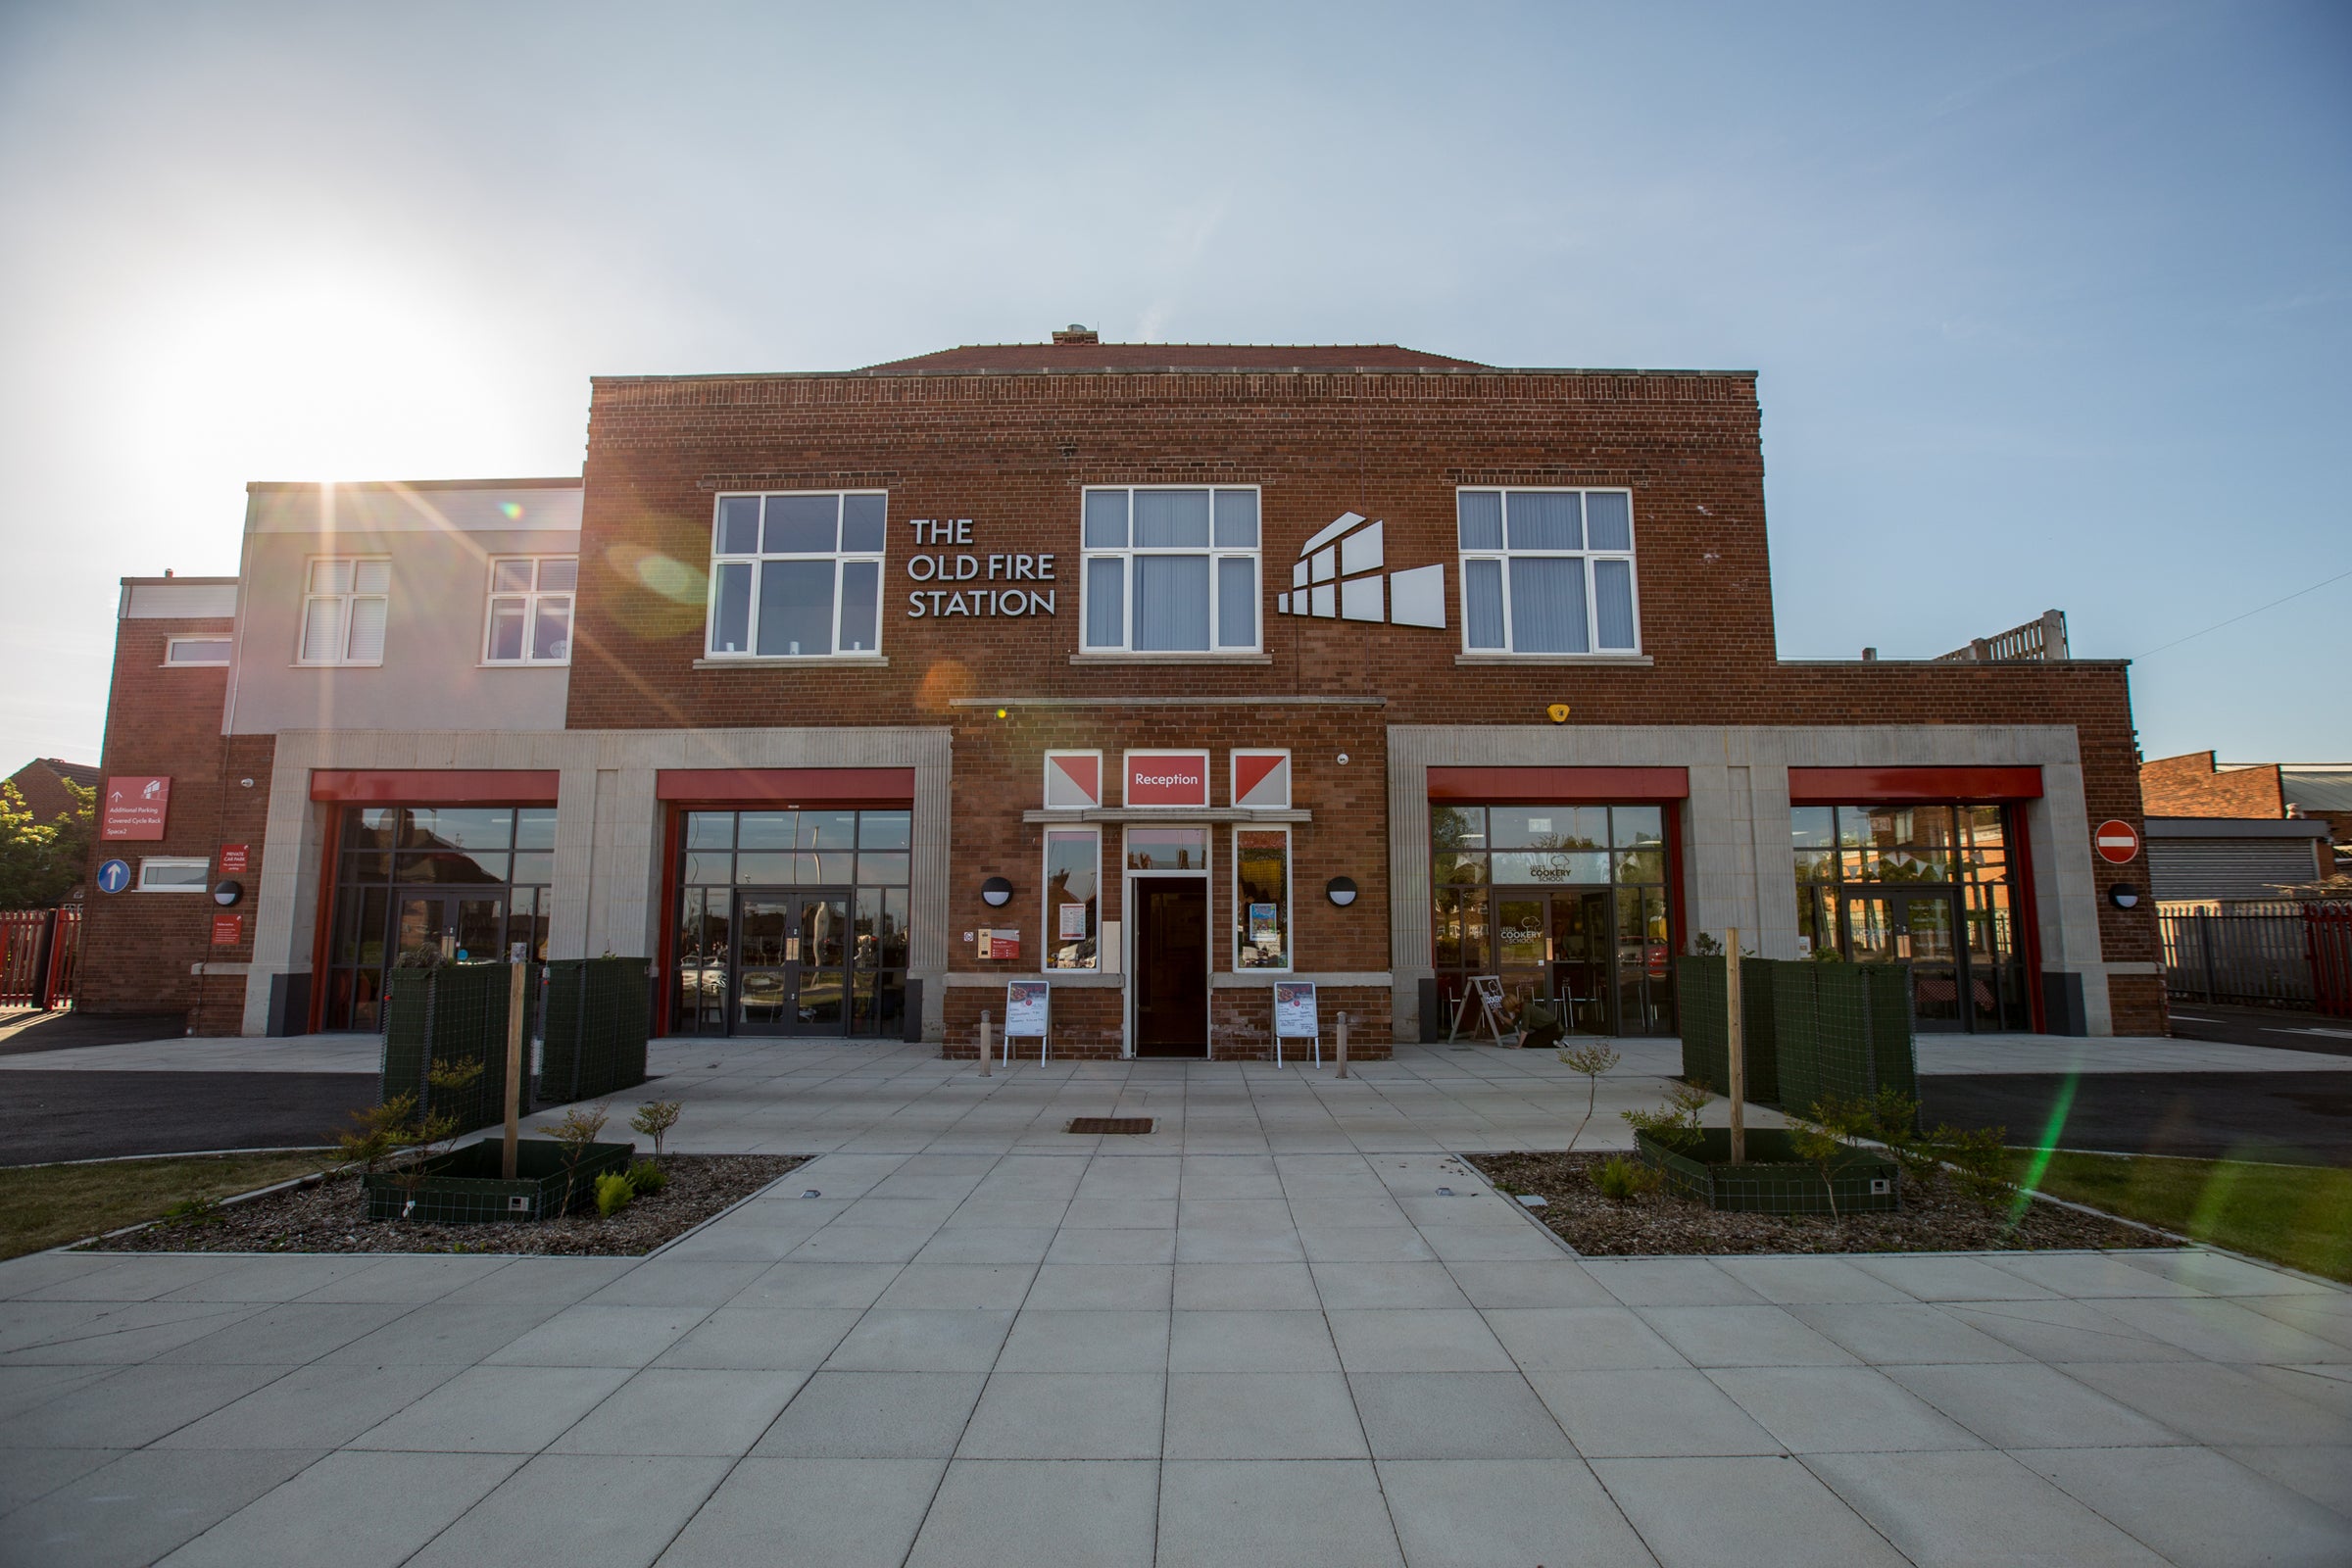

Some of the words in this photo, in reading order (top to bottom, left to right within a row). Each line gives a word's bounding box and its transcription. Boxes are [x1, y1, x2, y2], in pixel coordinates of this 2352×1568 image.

[909, 518, 973, 545] THE
[907, 554, 979, 581] OLD
[988, 554, 1055, 580] FIRE
[907, 589, 1055, 617] STATION
[1136, 773, 1198, 788] Reception
[1530, 868, 1571, 877] COOKERY
